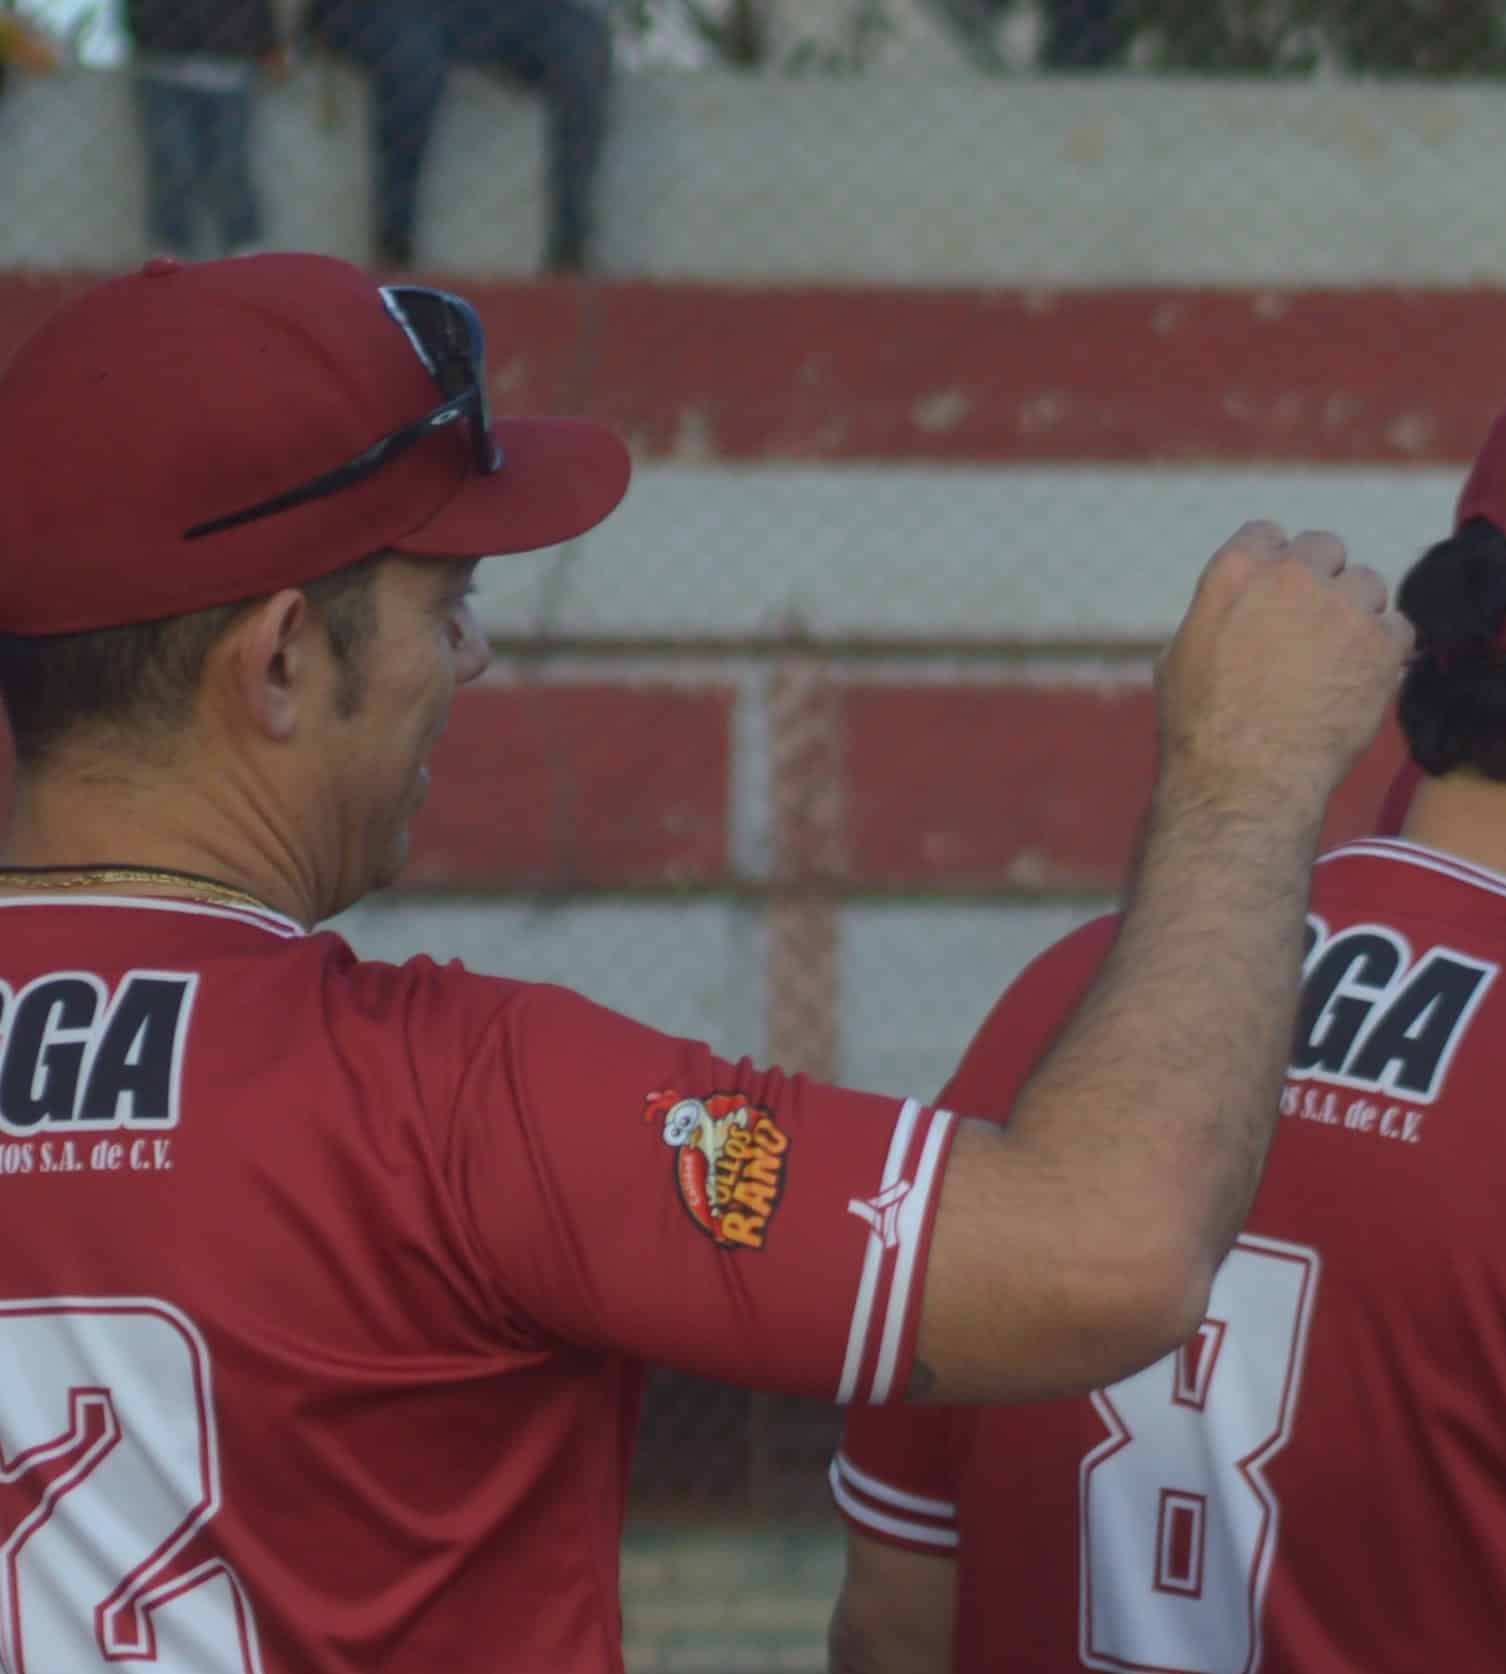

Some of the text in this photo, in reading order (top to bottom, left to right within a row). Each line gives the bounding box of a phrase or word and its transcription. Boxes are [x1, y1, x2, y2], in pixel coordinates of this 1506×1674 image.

[0, 969, 200, 1137] GA
[1286, 914, 1500, 1104] GA
[40, 1140, 84, 1172] S.A.
[90, 1139, 125, 1171] de
[130, 1139, 175, 1171] C.V.
[1343, 1098, 1378, 1132] de
